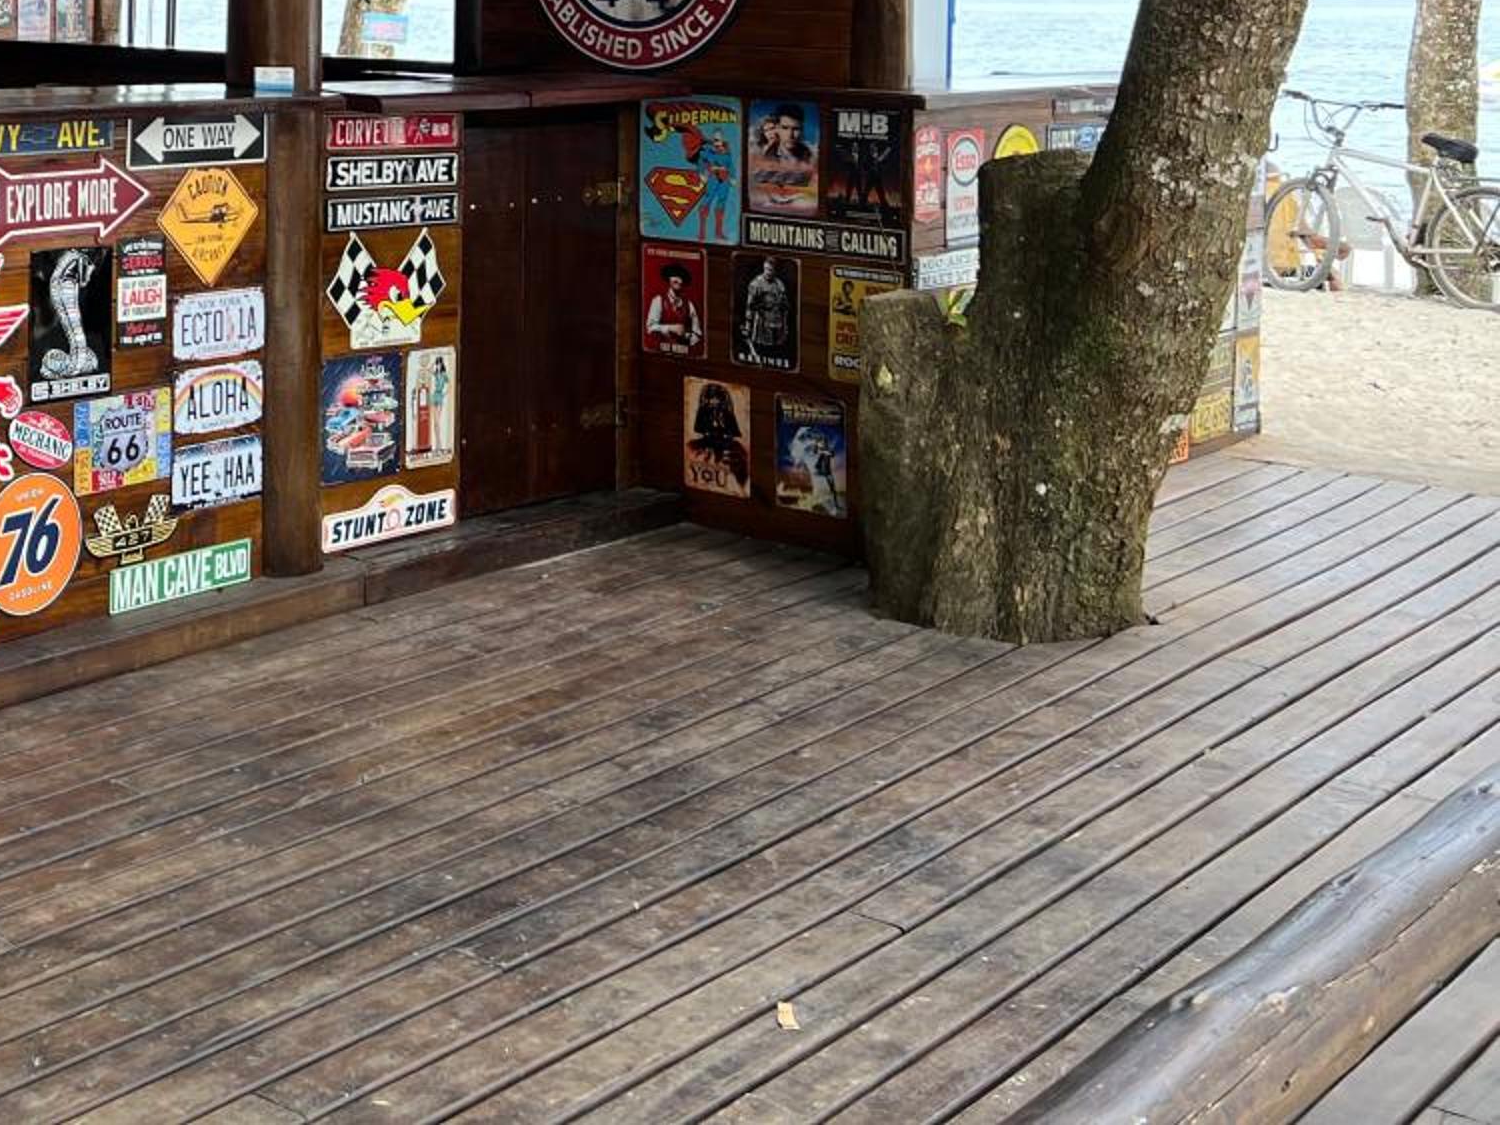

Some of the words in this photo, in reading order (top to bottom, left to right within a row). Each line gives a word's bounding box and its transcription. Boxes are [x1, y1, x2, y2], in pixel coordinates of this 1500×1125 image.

[650, 5, 715, 59] SINCE
[162, 127, 196, 149] ONE
[200, 125, 236, 148] WAY
[335, 160, 407, 185] SHELBY
[416, 158, 450, 182] AVE
[336, 200, 411, 226] MUSTANG
[424, 198, 451, 219] AVE
[749, 223, 826, 250] MOUNTAINS
[841, 231, 898, 257] CALLING
[122, 288, 163, 306] LAUGH
[186, 376, 250, 421] ALOHA
[103, 411, 143, 430] ROUTE
[179, 459, 214, 499] YEE
[222, 453, 256, 491] HAA
[692, 463, 729, 488] YOU
[331, 509, 386, 544] STUNT
[404, 498, 447, 528] ZONE
[114, 531, 151, 550] 427
